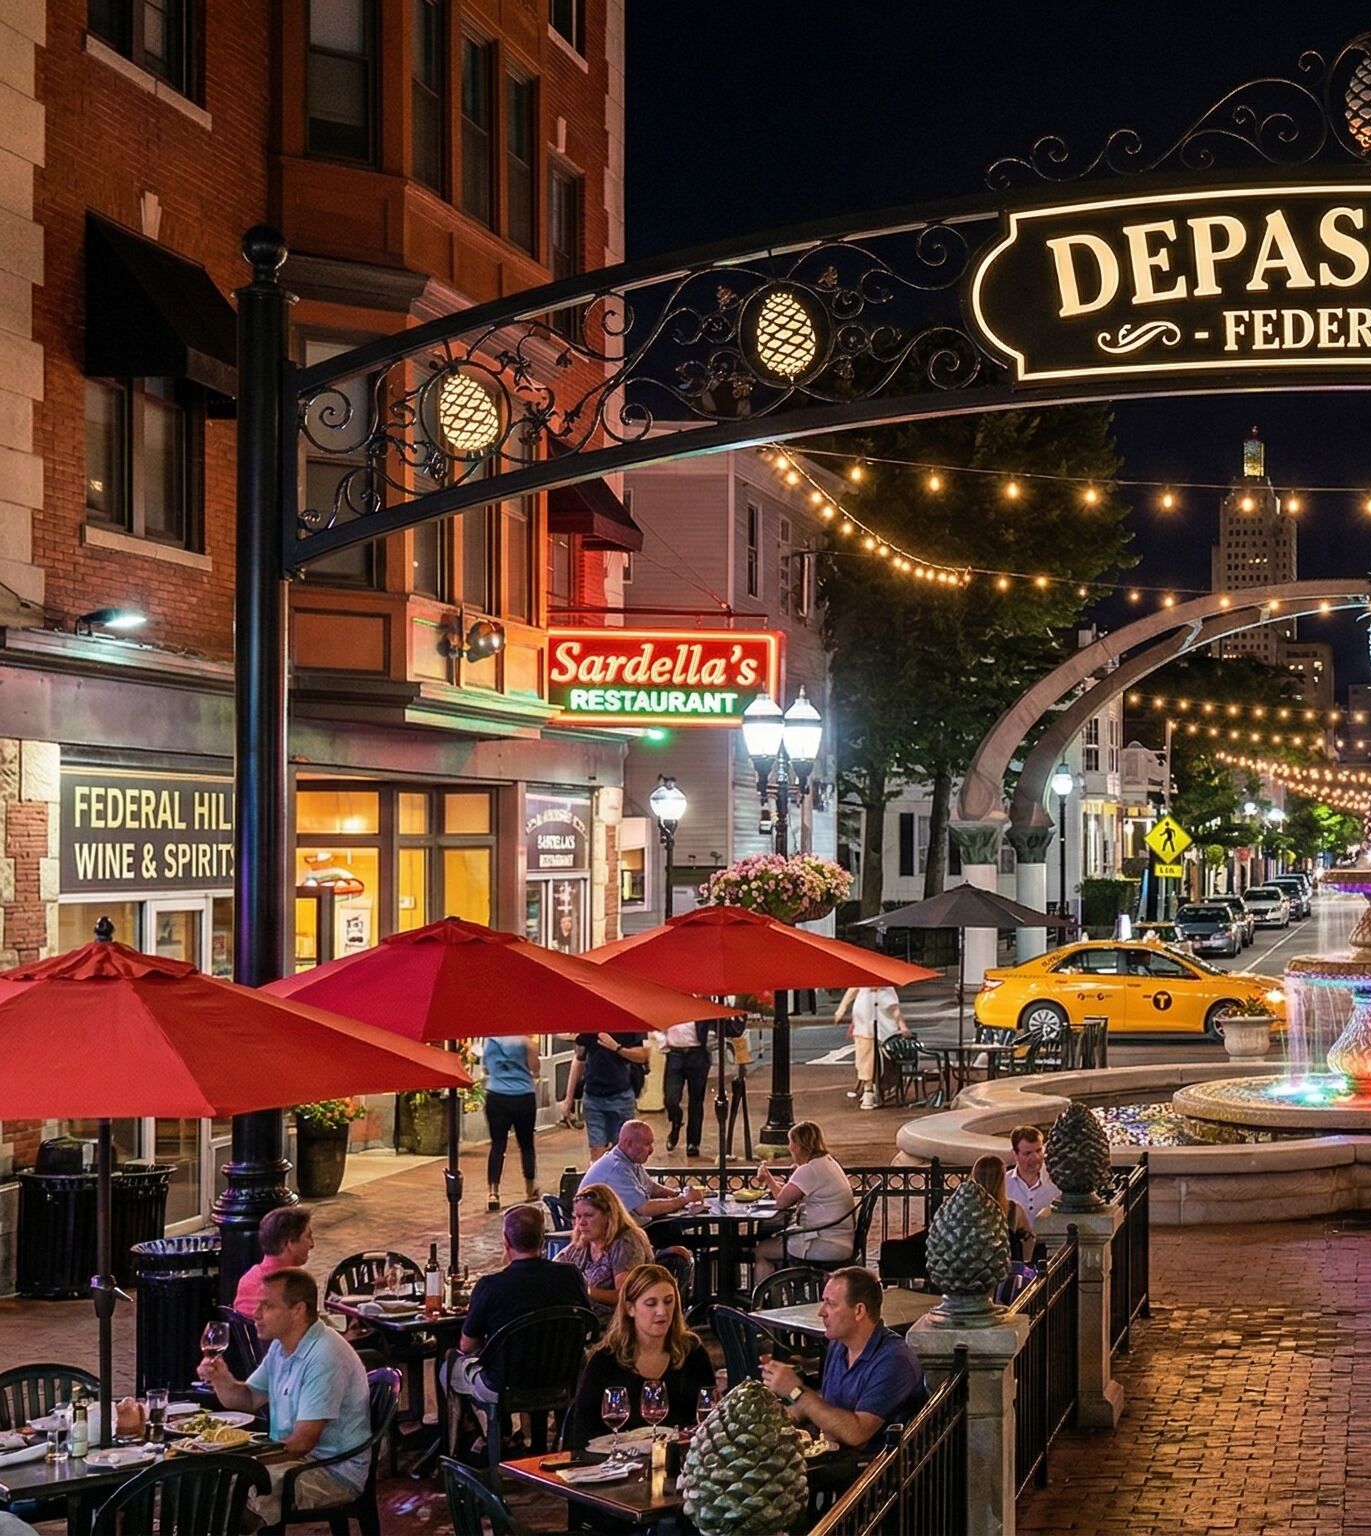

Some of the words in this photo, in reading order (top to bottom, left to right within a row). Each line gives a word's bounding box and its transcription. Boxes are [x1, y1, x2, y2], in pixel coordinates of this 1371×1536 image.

[550, 641, 759, 686] Sardella's
[570, 688, 739, 714] RESTAURANT
[74, 785, 187, 830] FEDERAL
[193, 791, 236, 831] HIL
[74, 843, 136, 881] WINE
[141, 842, 158, 880] &
